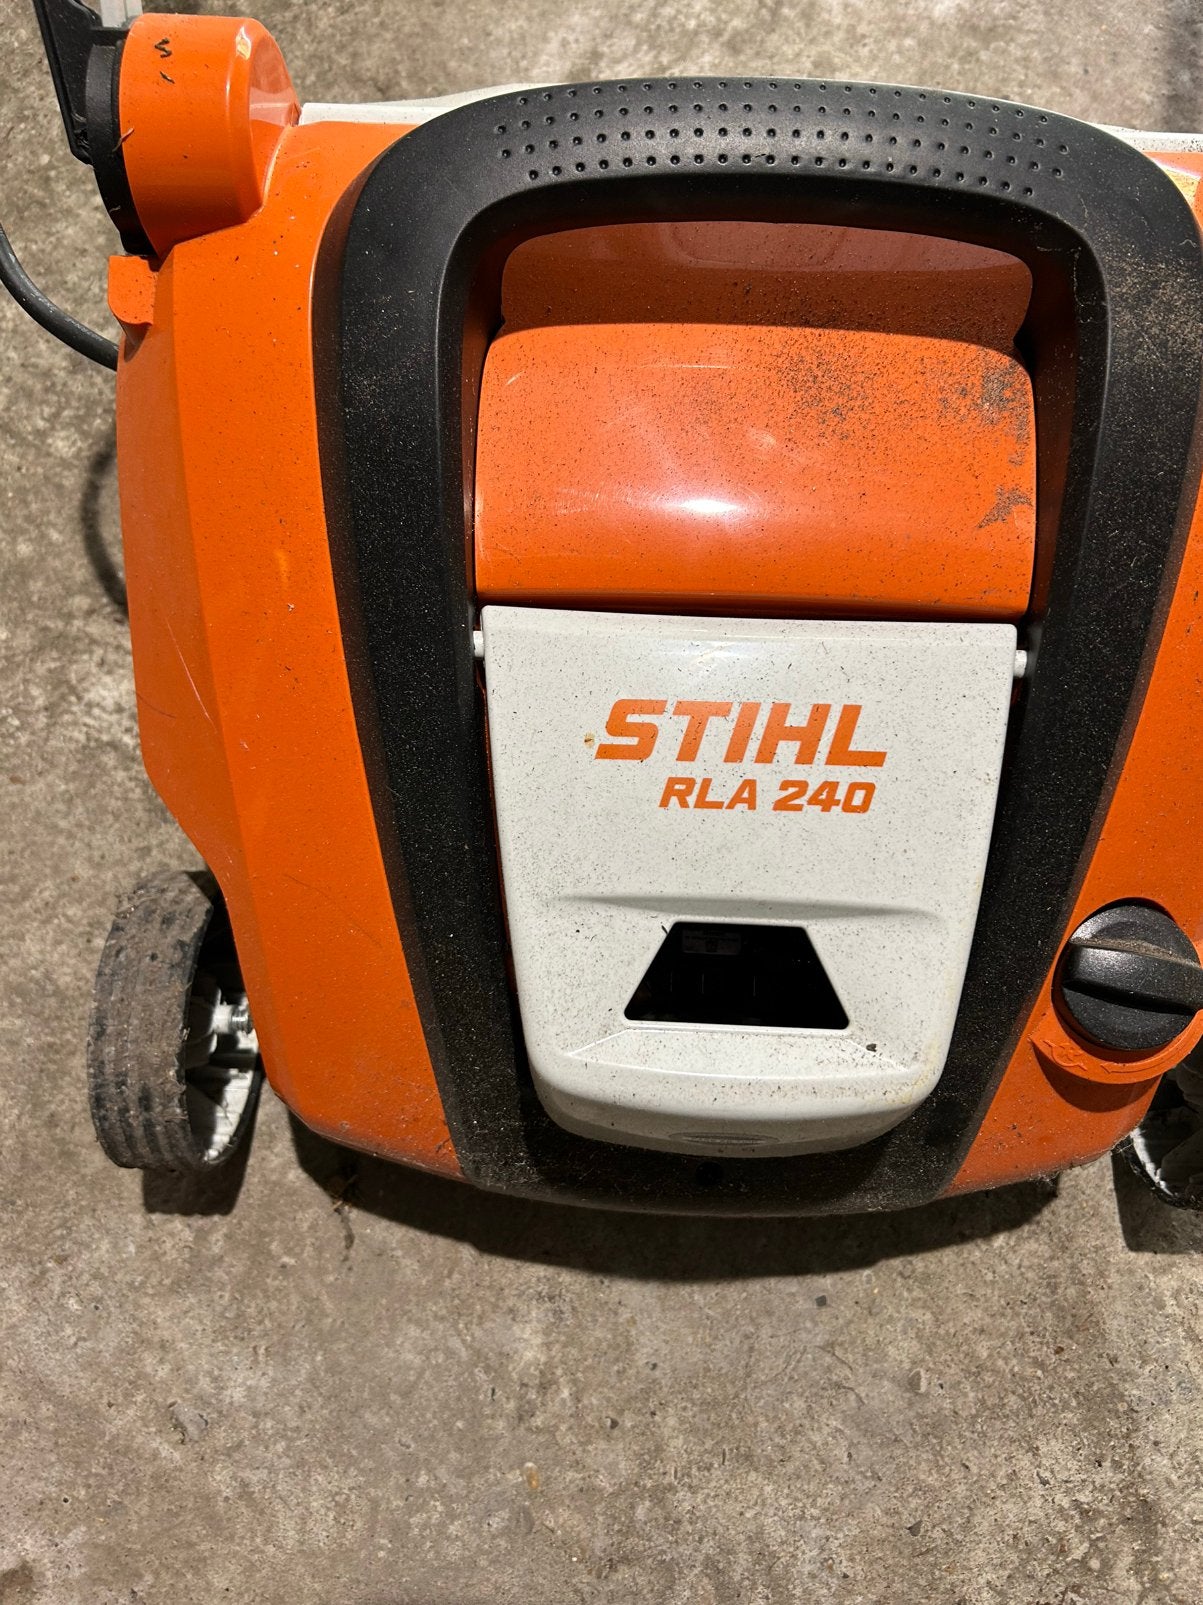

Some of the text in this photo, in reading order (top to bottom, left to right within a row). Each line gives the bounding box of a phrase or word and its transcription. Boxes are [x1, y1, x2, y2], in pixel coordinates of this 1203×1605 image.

[594, 698, 887, 767] STIHL
[658, 777, 876, 813] RLA 240
